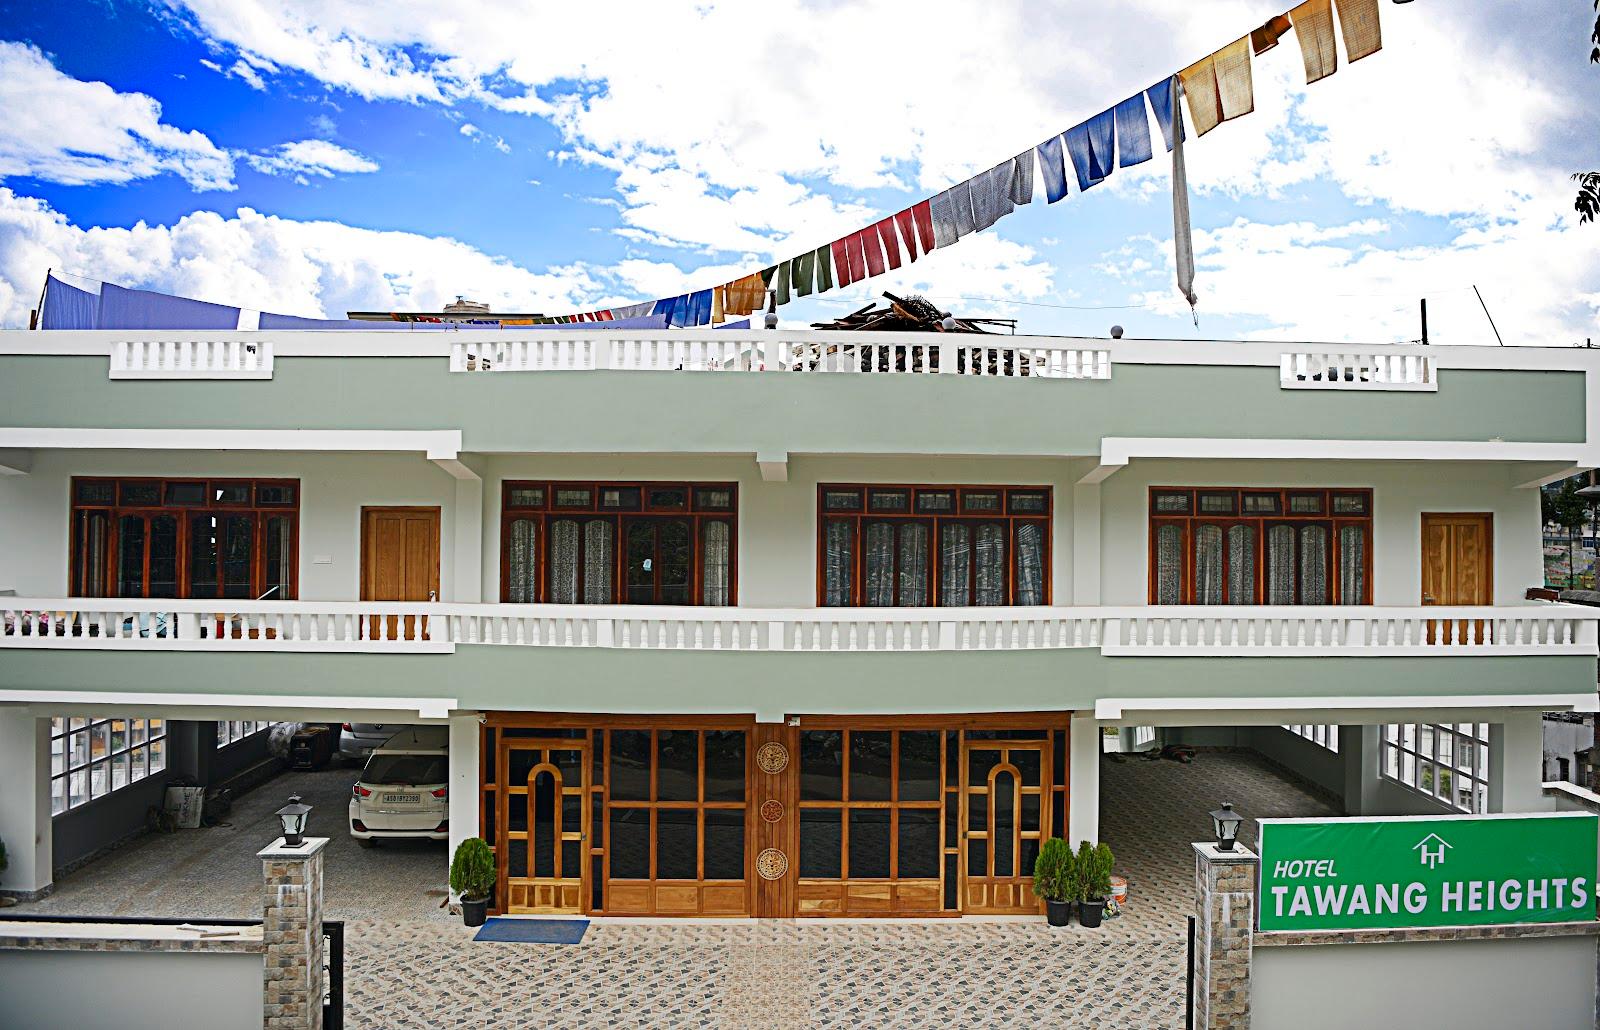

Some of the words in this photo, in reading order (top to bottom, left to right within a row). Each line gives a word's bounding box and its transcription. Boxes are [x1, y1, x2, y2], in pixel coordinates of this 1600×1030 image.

[1273, 859, 1338, 879] HOTEL
[1271, 881, 1428, 917] TAWANG
[1441, 877, 1588, 912] HEIGHTS
